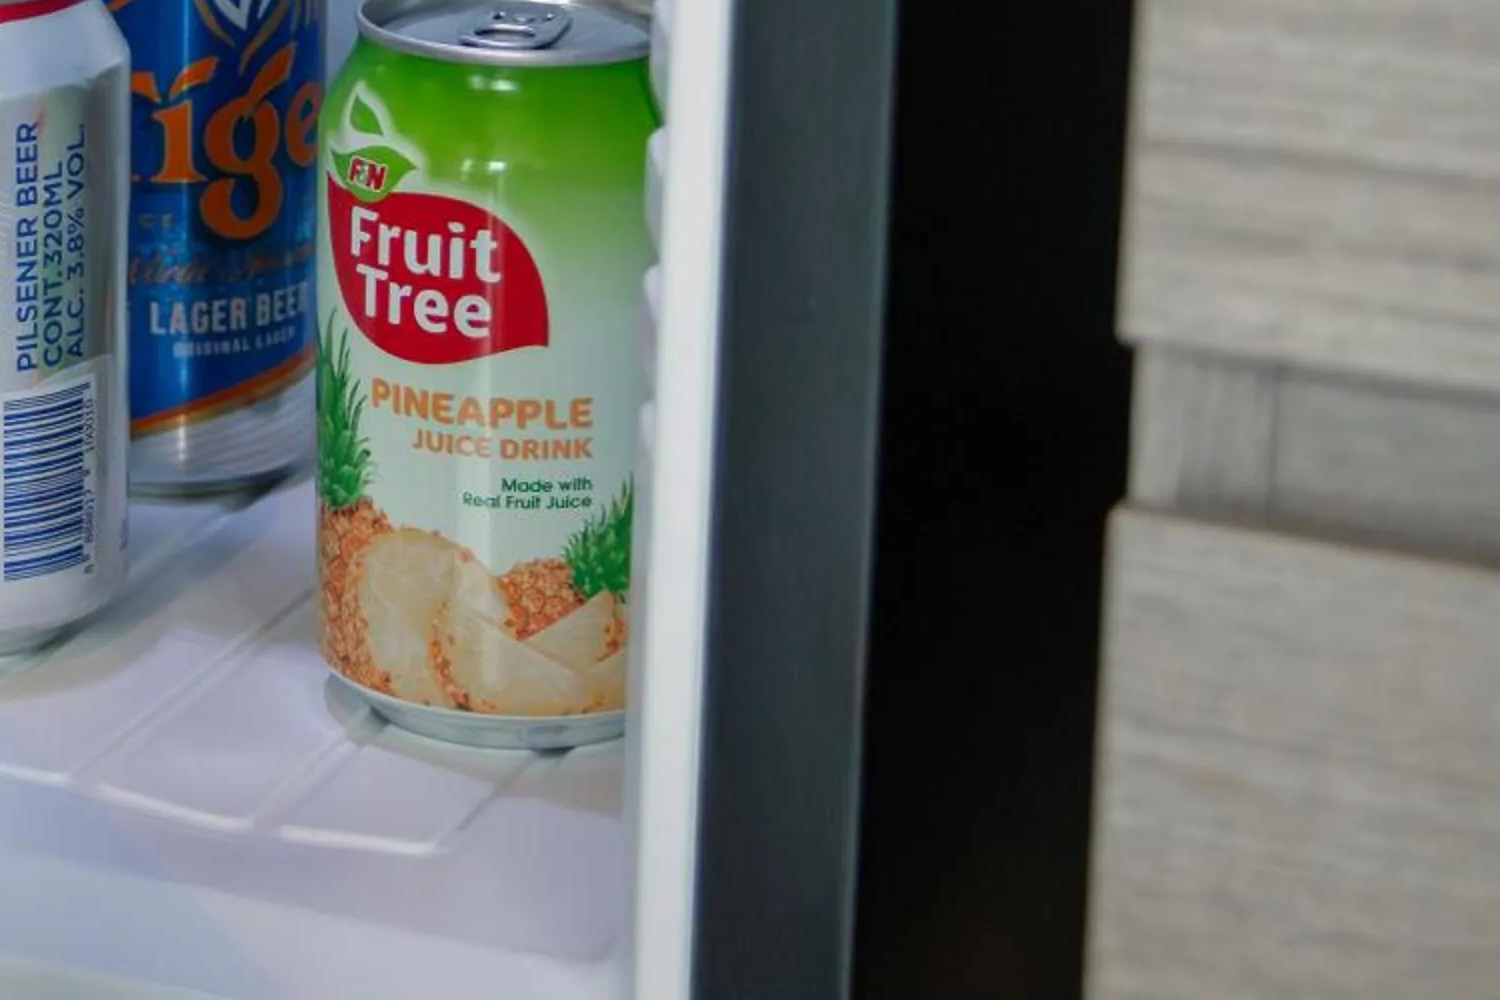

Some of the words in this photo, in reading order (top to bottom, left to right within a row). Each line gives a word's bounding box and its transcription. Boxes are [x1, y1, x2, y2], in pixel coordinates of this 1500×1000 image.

[16, 123, 38, 207] BEER
[131, 41, 324, 241] ige
[349, 156, 388, 191] F&N
[67, 207, 85, 281] 3.8%
[350, 206, 501, 283] Fruit
[16, 216, 38, 372] PILSENER
[67, 287, 85, 357] ALC.
[150, 297, 247, 335] LAGER
[356, 264, 491, 338] Tree
[371, 377, 593, 430] PINEAPPLE
[413, 429, 491, 458] JUICE
[500, 437, 593, 460] DRINK
[463, 491, 501, 508] Real
[505, 494, 541, 510] Fruit
[546, 494, 593, 510] Juice
[501, 477, 553, 493] Made
[559, 477, 593, 493] with
